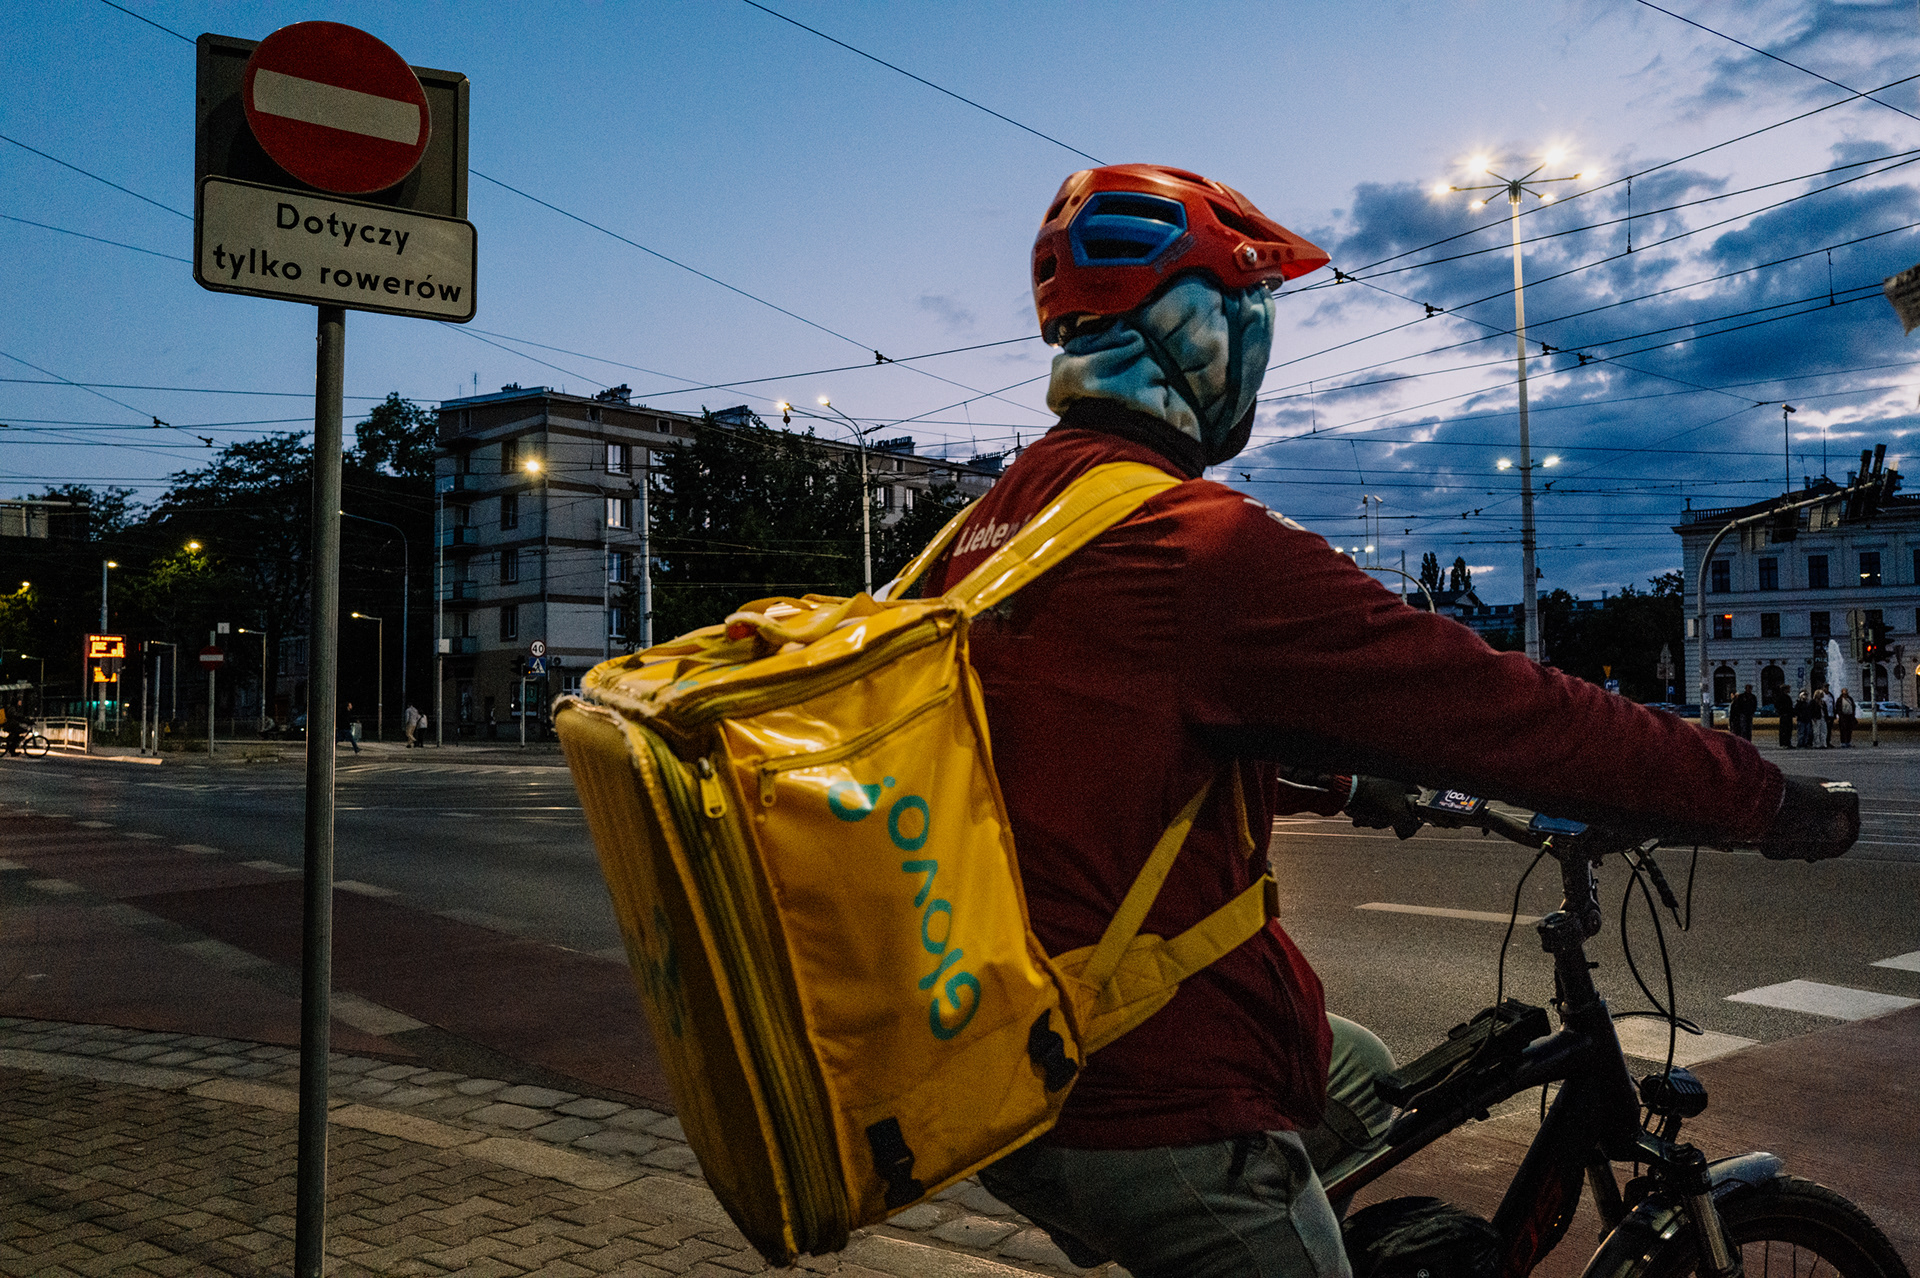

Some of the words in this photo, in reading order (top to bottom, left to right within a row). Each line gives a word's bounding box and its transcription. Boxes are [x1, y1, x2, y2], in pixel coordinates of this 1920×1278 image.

[276, 202, 410, 255] Dotyczy
[212, 243, 302, 280] tylko
[319, 266, 462, 303] rowerów
[532, 644, 544, 653] 40
